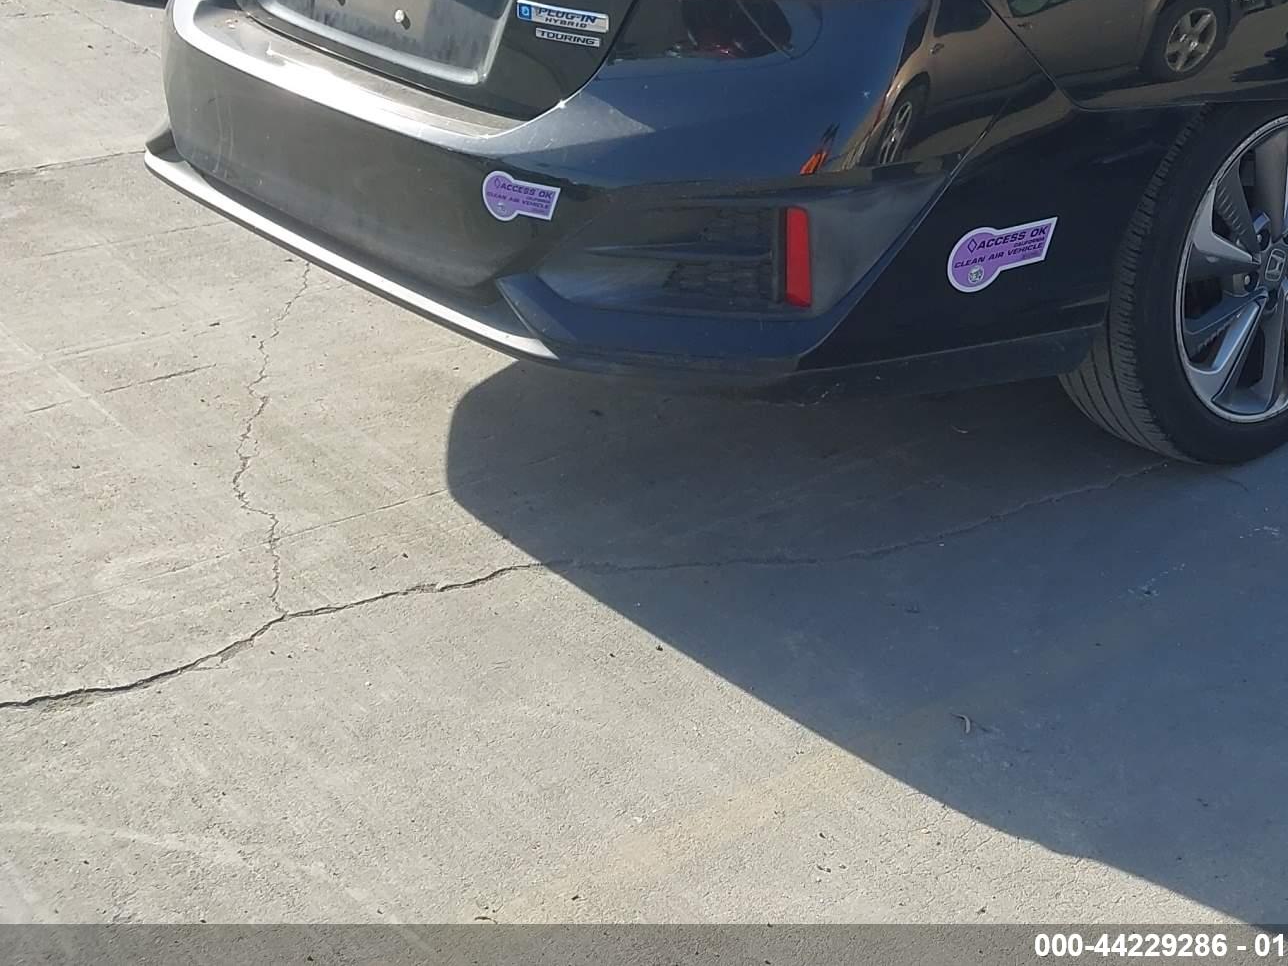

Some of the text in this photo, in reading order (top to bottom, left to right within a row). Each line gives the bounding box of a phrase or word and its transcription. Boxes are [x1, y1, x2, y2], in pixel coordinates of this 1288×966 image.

[538, 7, 597, 24] PLUG-IN
[544, 16, 588, 29] HYBRID
[539, 30, 596, 45] TOURING
[500, 182, 536, 196] ACCESS
[538, 189, 553, 200] OK
[976, 224, 1049, 251] ACCESS OK
[953, 242, 1043, 269] CLEAN AIR VEHICLE
